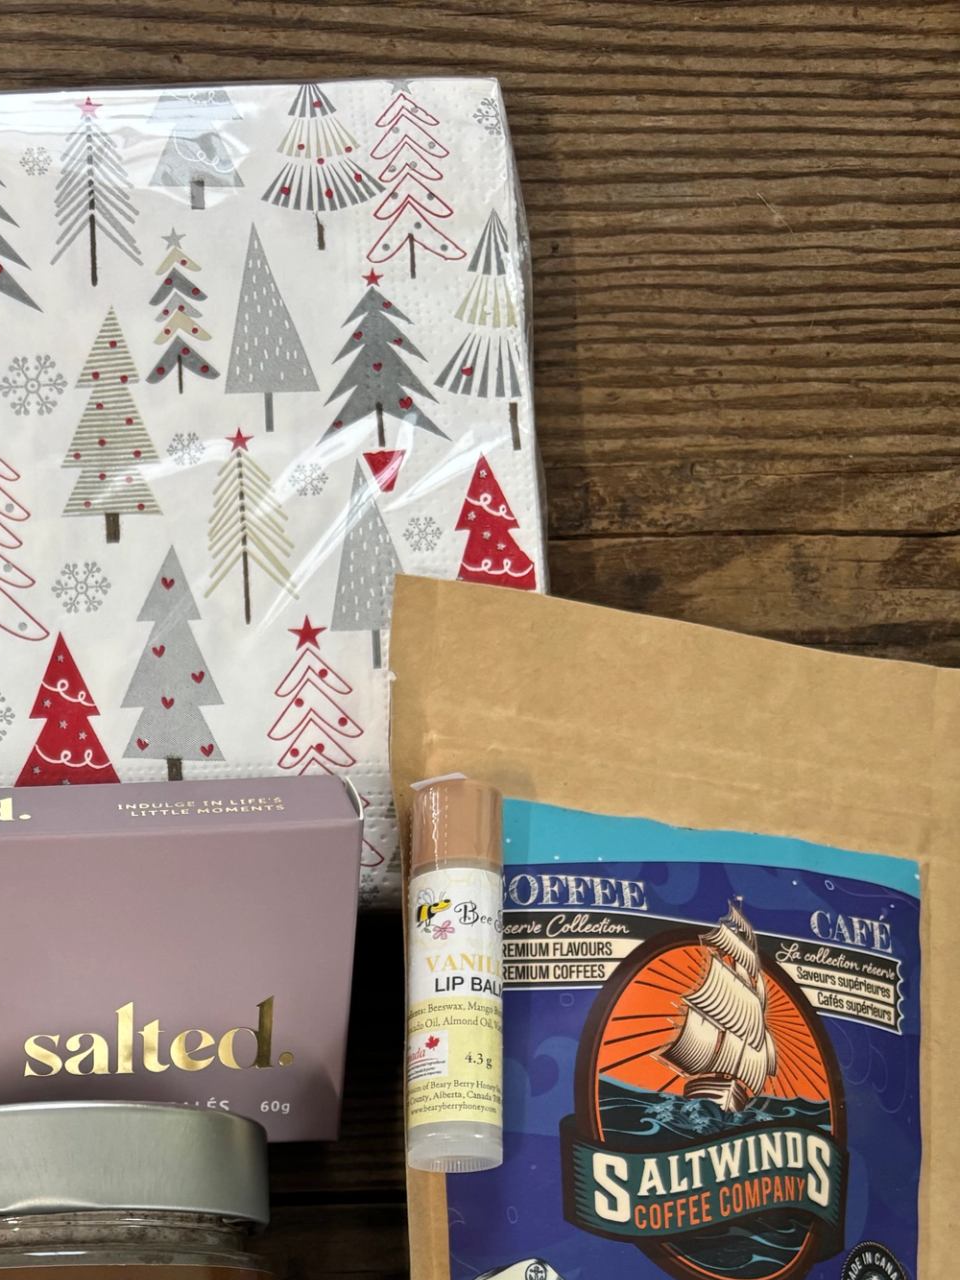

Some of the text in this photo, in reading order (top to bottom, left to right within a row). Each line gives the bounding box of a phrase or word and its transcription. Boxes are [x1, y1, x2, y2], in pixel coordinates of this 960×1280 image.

[118, 796, 282, 811] INDULGE IN LIFE'S
[131, 804, 285, 817] LITTLE MOMENTS
[503, 873, 648, 911] OFFEE
[454, 900, 493, 927] Bee
[502, 920, 542, 935] serve
[545, 913, 630, 938] Collection
[810, 910, 893, 954] CAFÉ
[502, 941, 613, 958] REMIUM FLAVOURS
[775, 942, 896, 980] La collection réserve
[502, 963, 606, 981] REMIUM COFFEES
[435, 976, 464, 992] LIP
[796, 966, 891, 1000] Saveurs supérieures
[817, 991, 892, 1022] Cafés supérieurs
[443, 1016, 479, 1026] Almond
[23, 995, 294, 1078] salted.
[465, 1051, 493, 1070] 4.3 g
[454, 1079, 476, 1089] Berry
[433, 1090, 466, 1100] Alberta,
[260, 1099, 291, 1116] 60g
[592, 1131, 831, 1223] SALTWINDS
[634, 1175, 806, 1230] COFFEE COMPANY
[861, 1251, 873, 1265] IN
